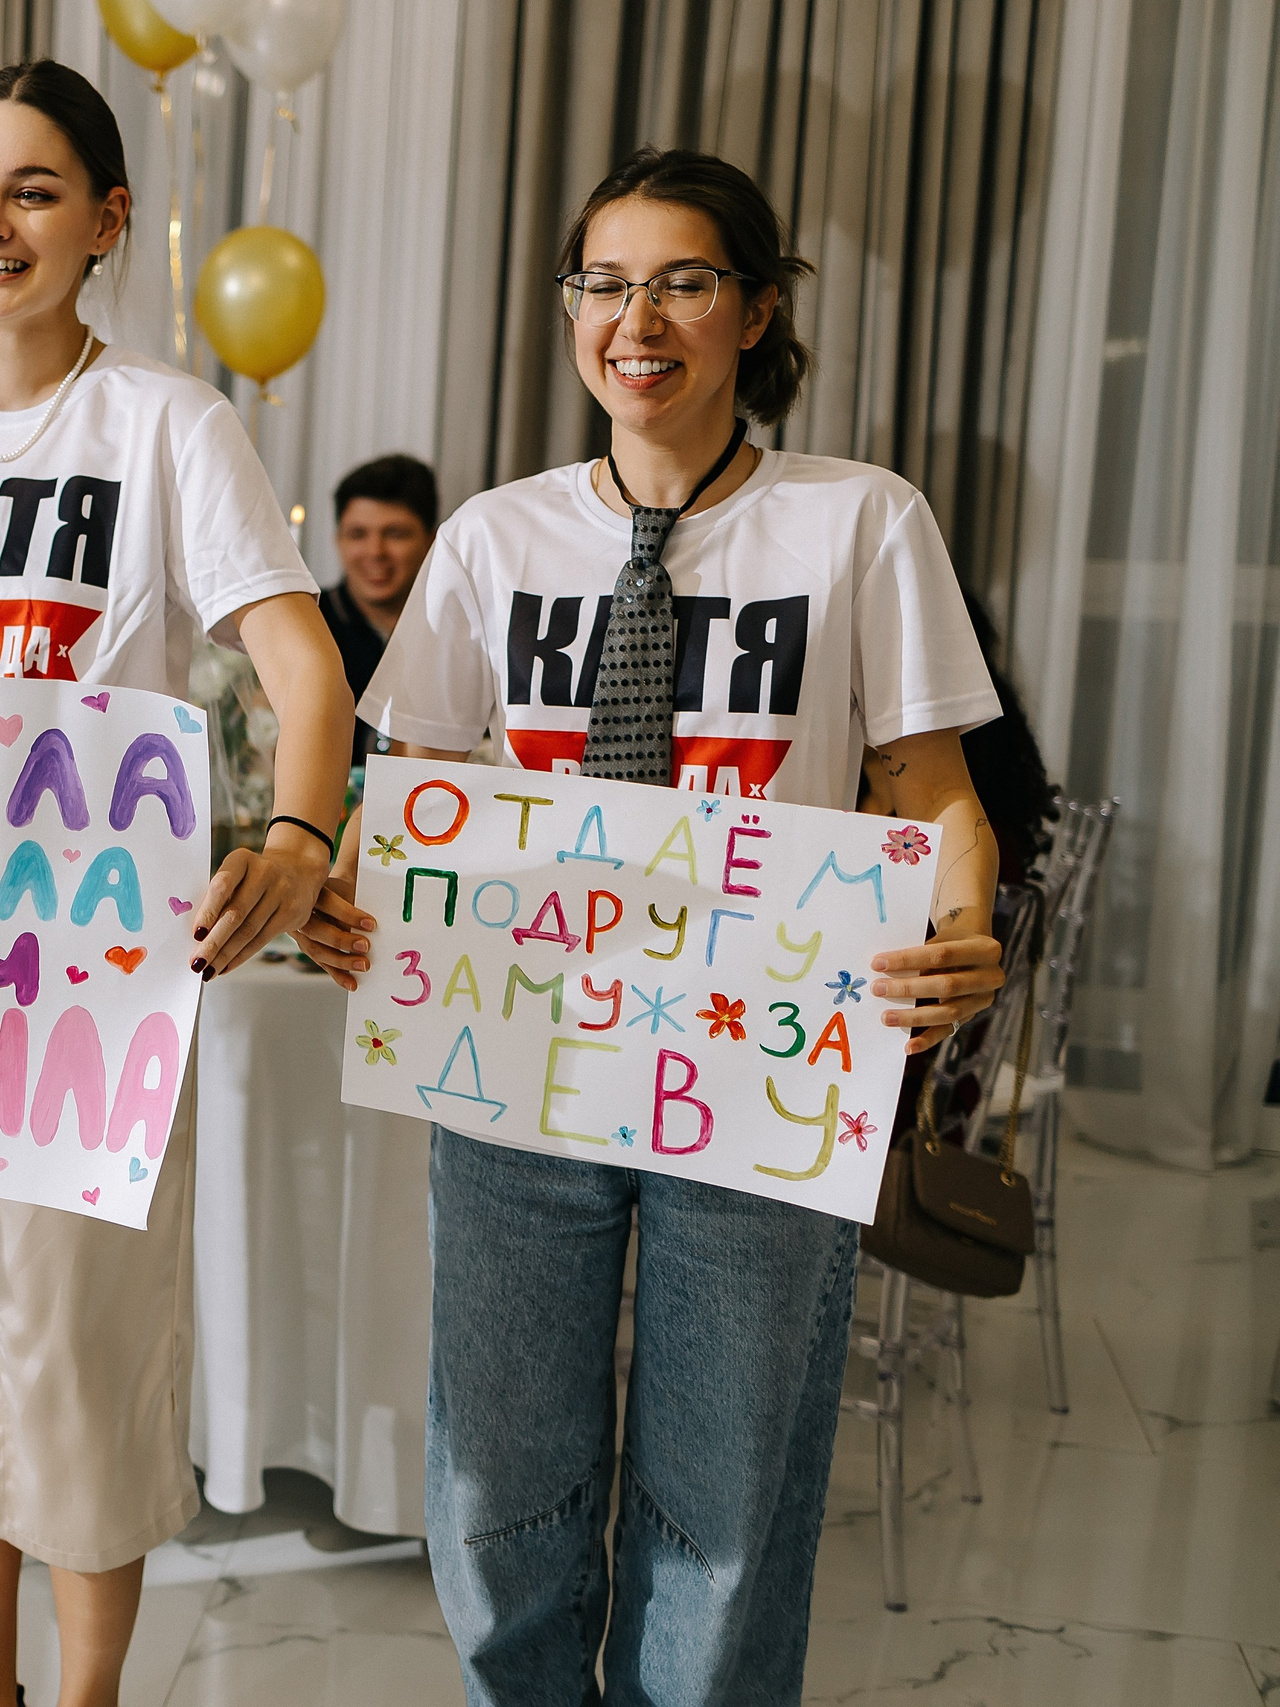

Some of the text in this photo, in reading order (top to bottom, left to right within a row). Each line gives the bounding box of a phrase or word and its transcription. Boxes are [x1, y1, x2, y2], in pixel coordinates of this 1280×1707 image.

[403, 778, 887, 923] ОТДАЁМ
[402, 866, 823, 983] ПОДРУГУ
[390, 949, 853, 1074] ЗАМУЖ ЗА
[416, 1025, 841, 1182] ДЕВУ
